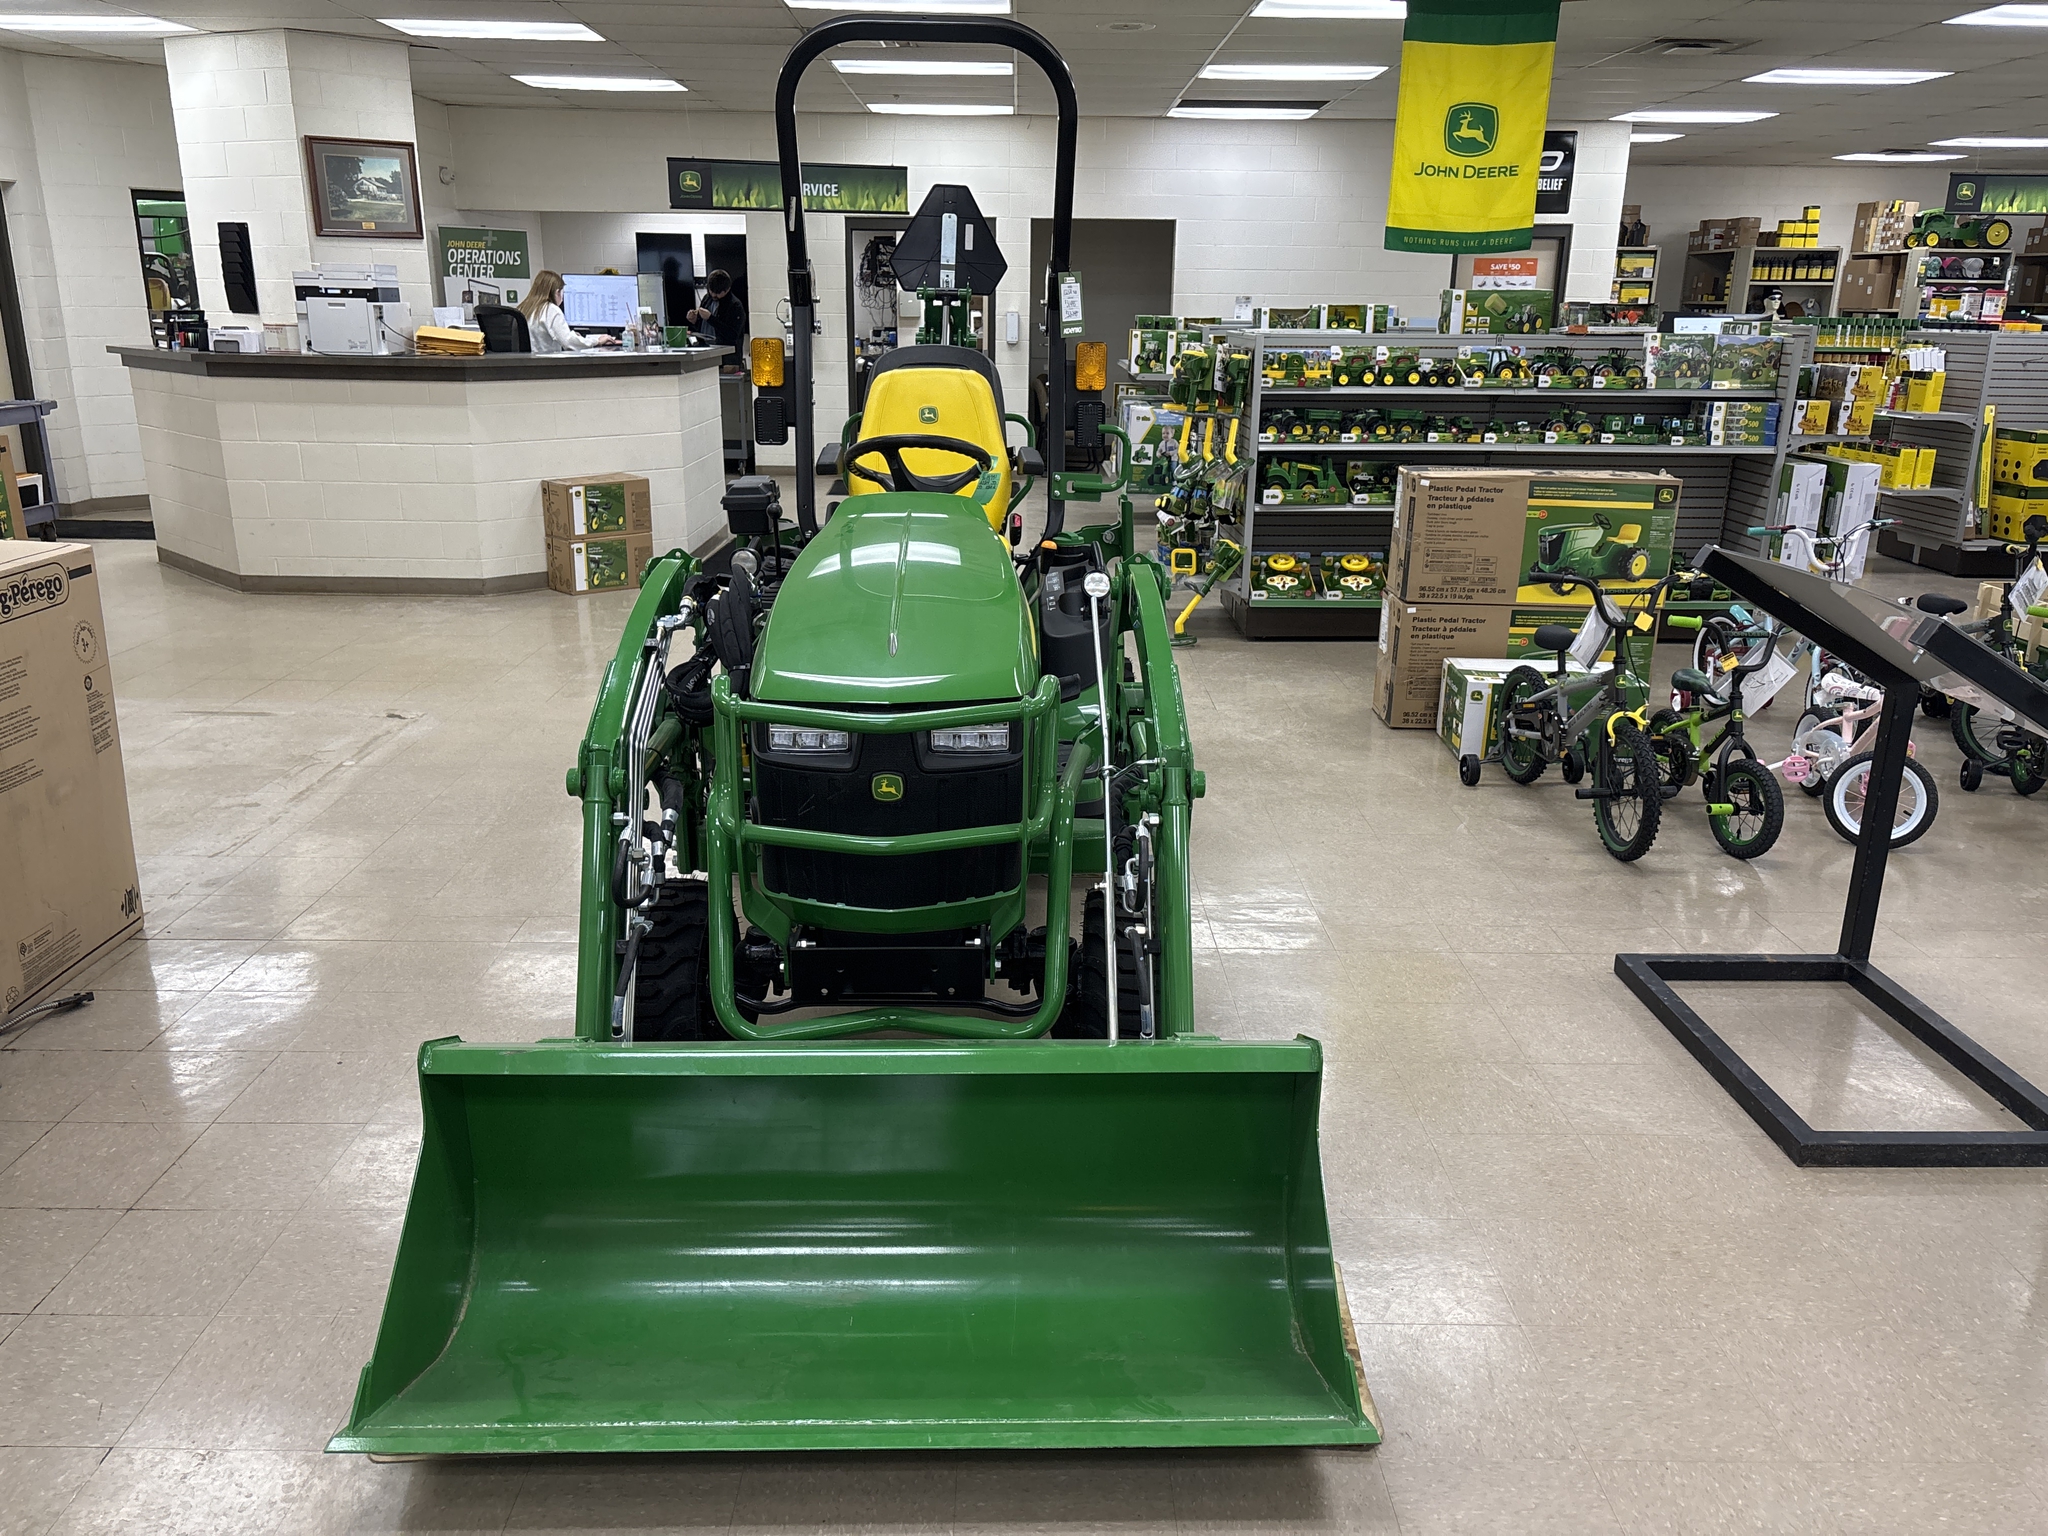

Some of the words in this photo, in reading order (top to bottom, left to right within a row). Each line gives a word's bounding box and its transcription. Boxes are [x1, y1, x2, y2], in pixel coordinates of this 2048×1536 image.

[1414, 162, 1459, 178] JOHN
[1463, 165, 1519, 178] DEERE
[1537, 178, 1564, 190] BELIEF
[803, 183, 839, 197] RVICE
[447, 240, 466, 248] JOHN
[1404, 236, 1437, 245] NOTHING
[1440, 237, 1460, 247] RUNS
[1463, 239, 1479, 247] LIKE
[1482, 238, 1487, 246] A
[1490, 236, 1513, 246] DEERE
[448, 249, 521, 265] OPERATIONS
[449, 264, 495, 278] CENTER
[1478, 486, 1504, 494] Tractor
[1466, 495, 1494, 503] pédales
[1438, 502, 1472, 510] plastique
